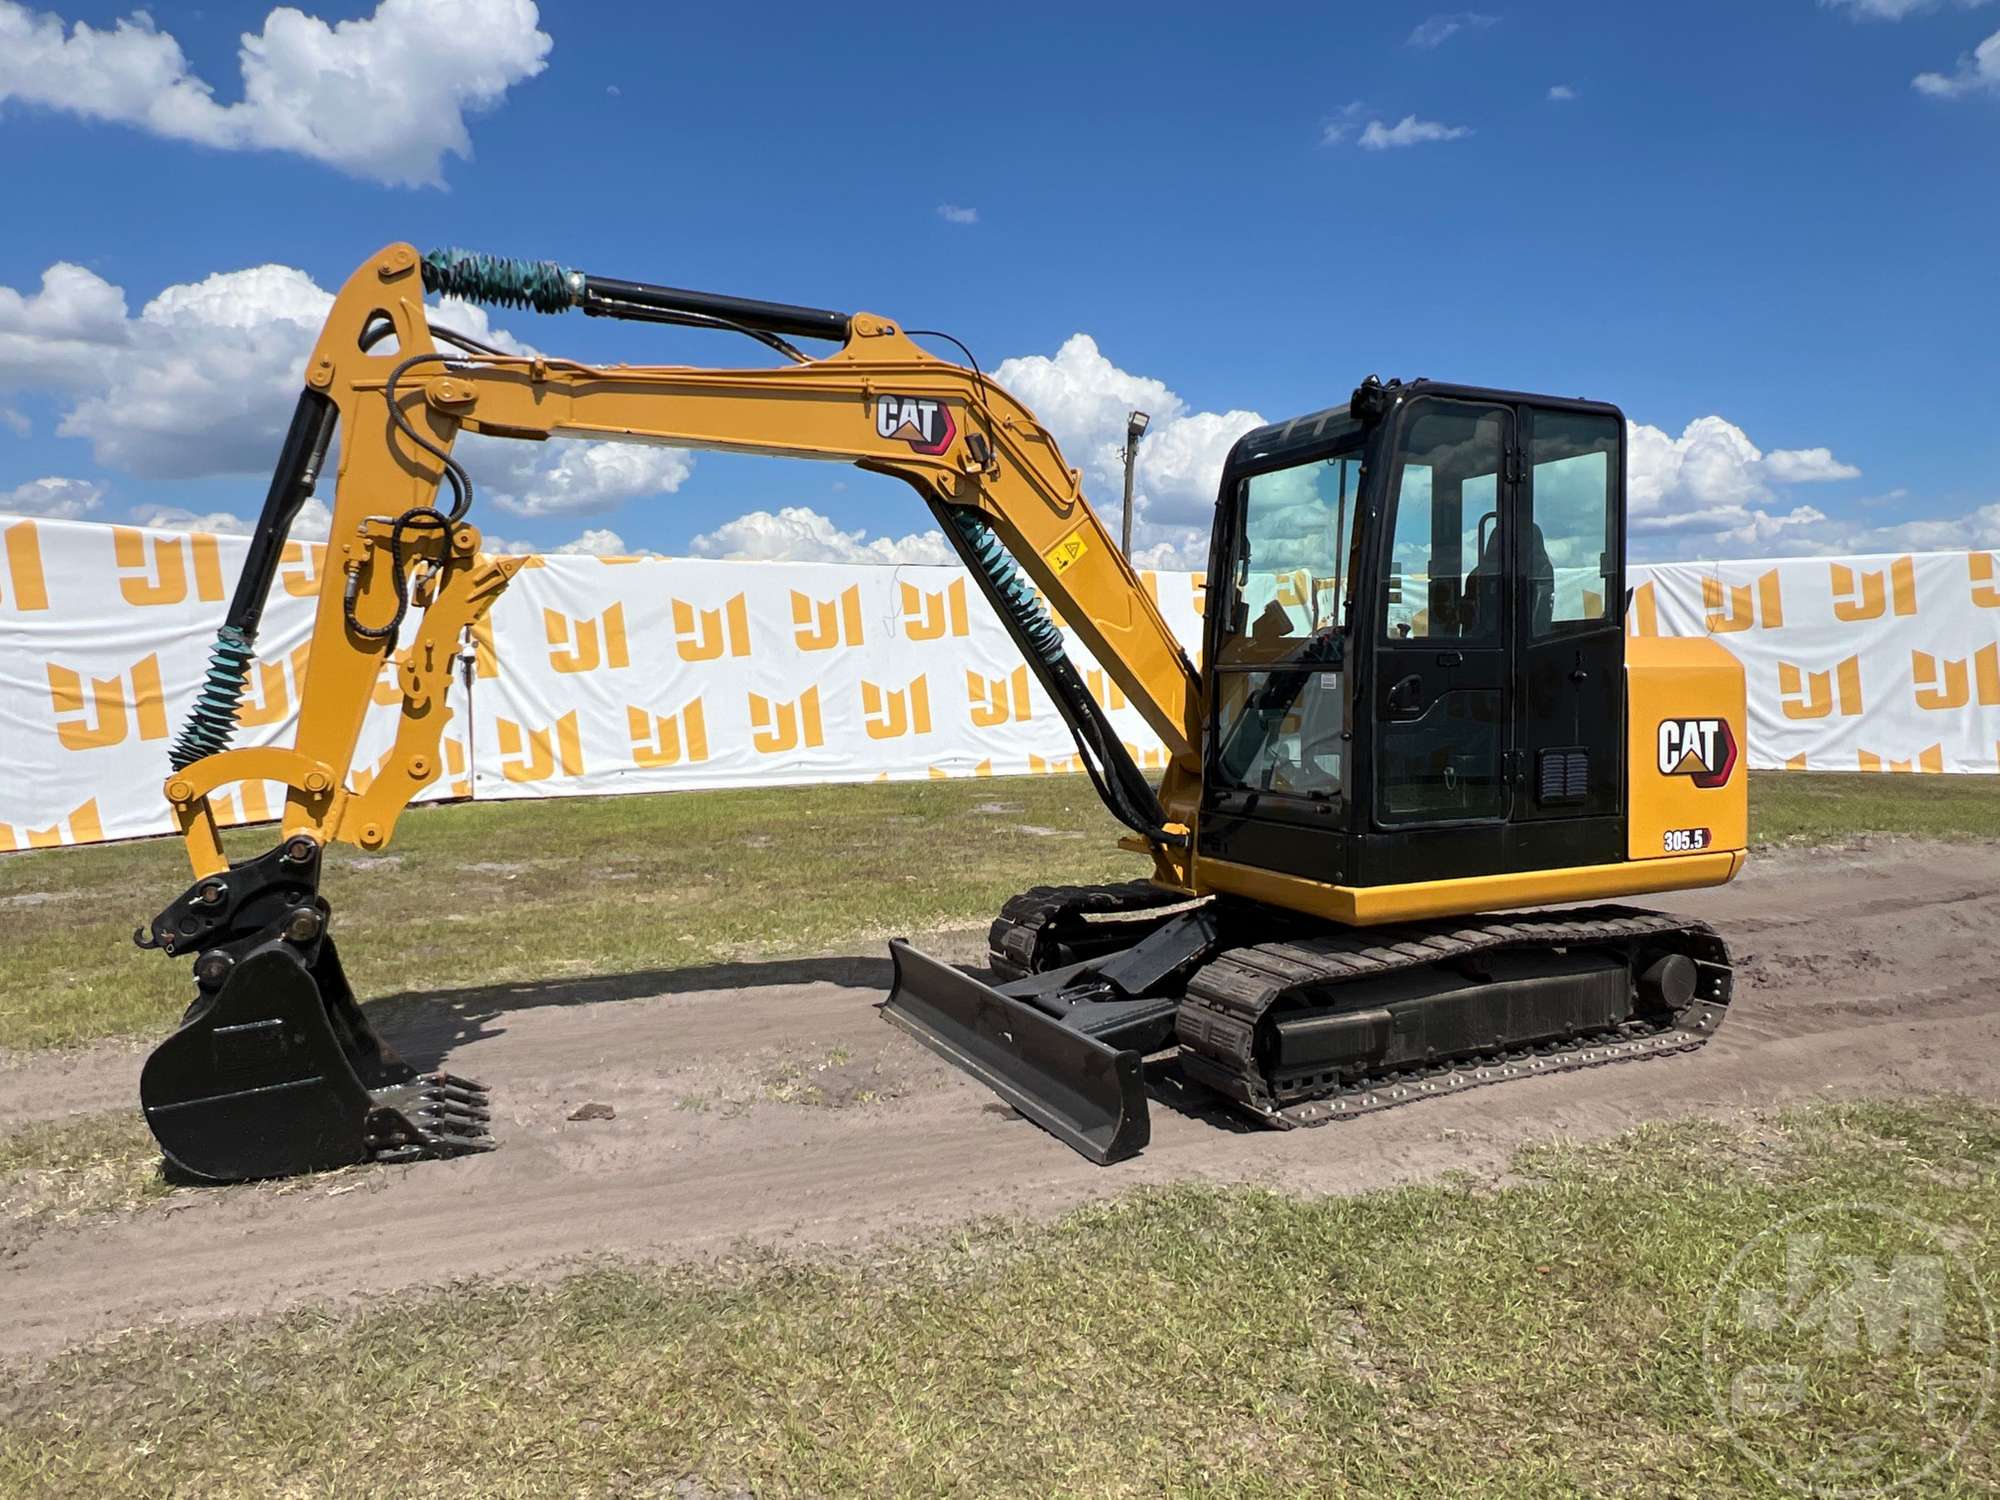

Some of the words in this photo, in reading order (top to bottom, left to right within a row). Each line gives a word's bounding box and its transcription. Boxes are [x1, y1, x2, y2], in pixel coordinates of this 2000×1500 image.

[878, 395, 937, 442] CAT
[1659, 720, 1719, 774] CAT
[1664, 829, 1703, 851] 305.5
